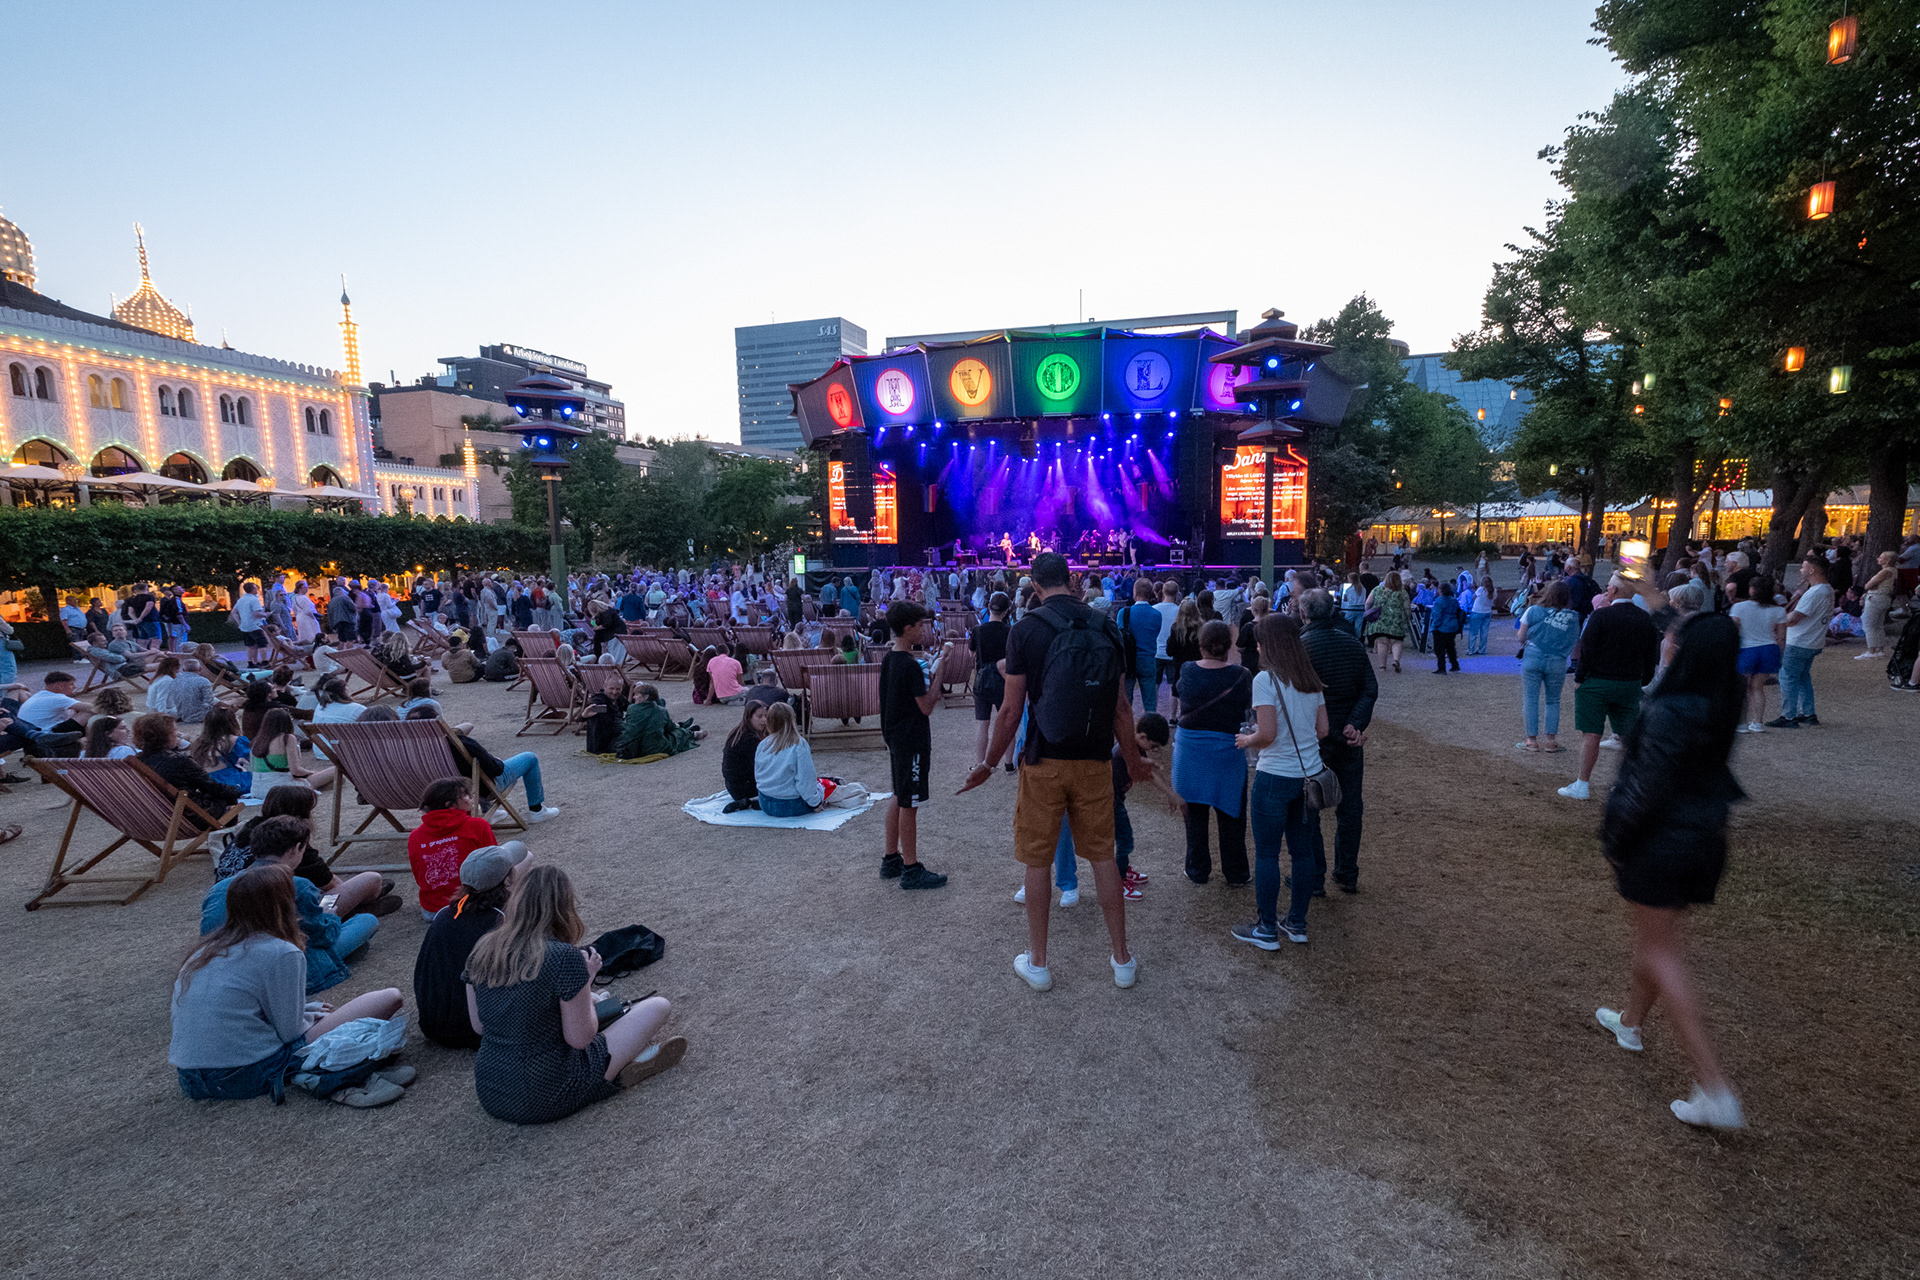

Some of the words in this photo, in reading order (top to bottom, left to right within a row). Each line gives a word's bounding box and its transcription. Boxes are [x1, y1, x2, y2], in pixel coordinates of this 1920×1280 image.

[817, 324, 838, 336] SAS
[830, 390, 846, 419] T
[955, 368, 985, 400] V
[1134, 359, 1164, 390] L
